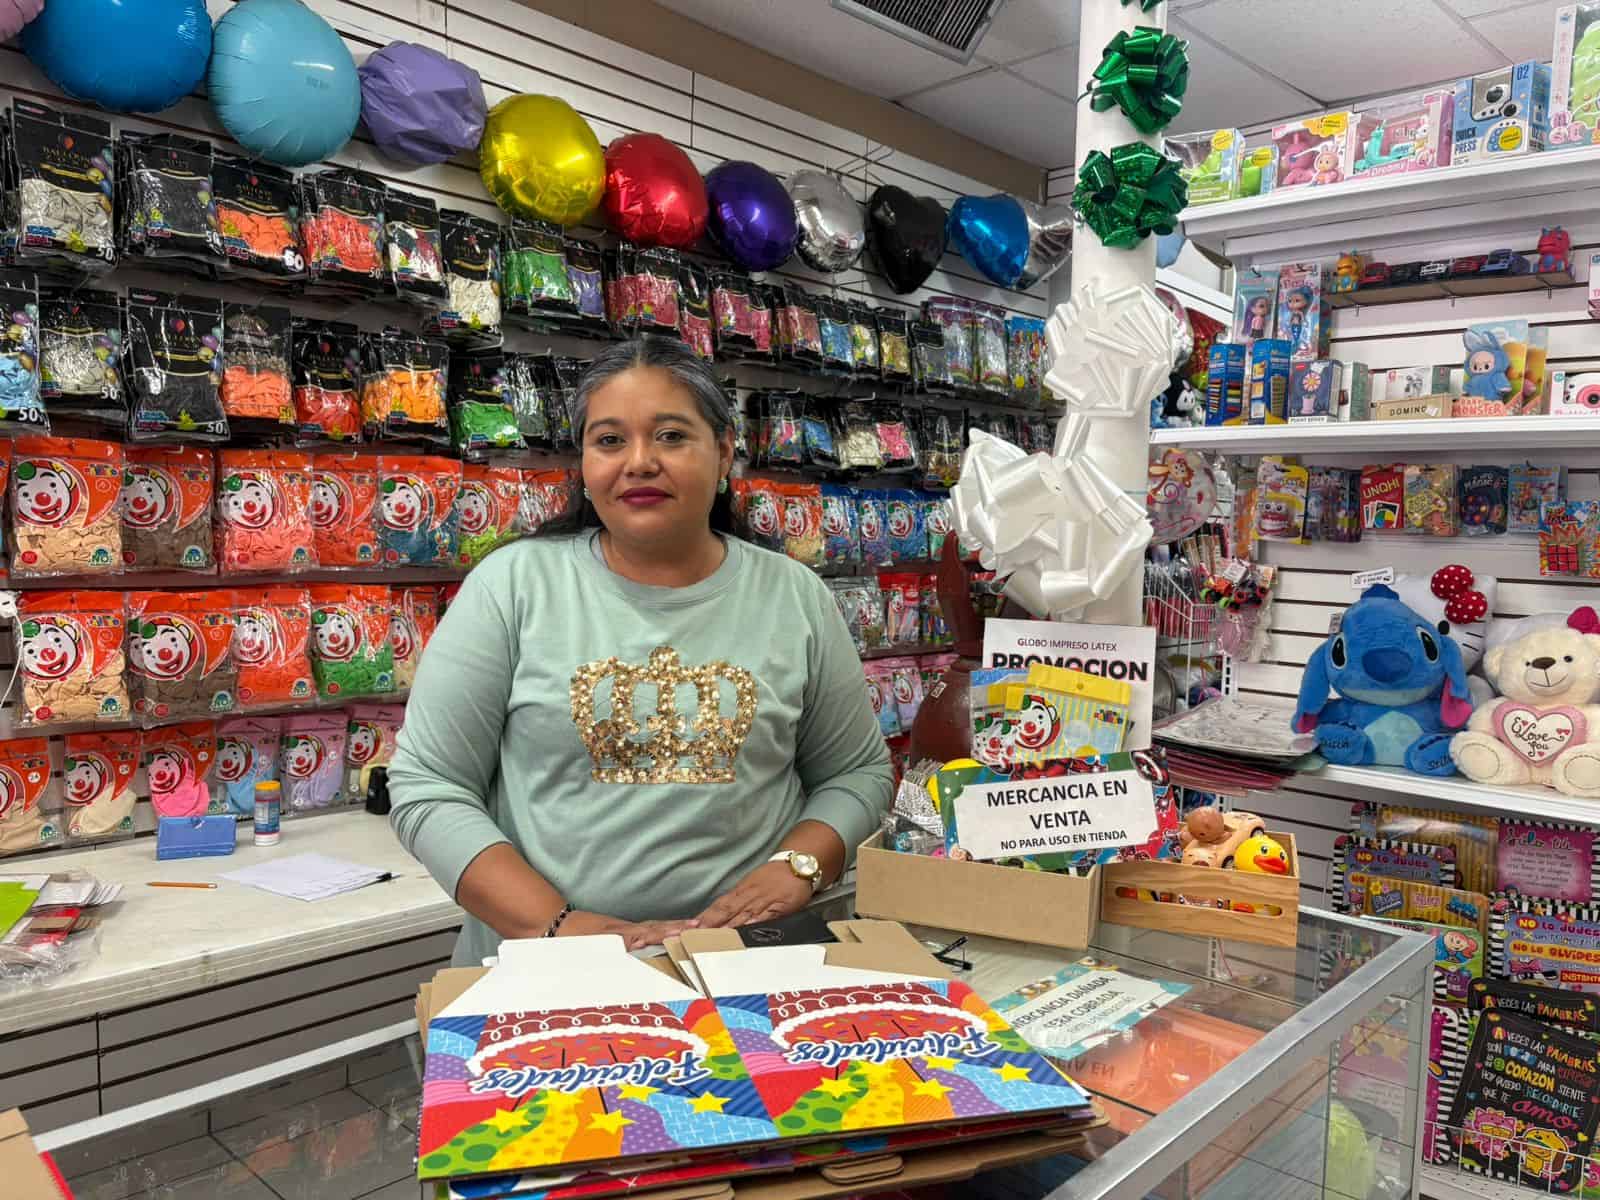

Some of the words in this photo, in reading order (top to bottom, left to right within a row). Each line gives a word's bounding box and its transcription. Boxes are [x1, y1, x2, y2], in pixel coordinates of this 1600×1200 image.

[1456, 127, 1477, 142] QUICK
[1456, 141, 1477, 154] PRESS
[96, 246, 115, 261] 50
[100, 386, 119, 400] 50
[18, 407, 39, 422] 50
[1389, 405, 1427, 417] DOMINO
[206, 422, 224, 434] 50
[1017, 638, 1047, 648] GLOBO
[1050, 640, 1089, 650] IMPRESO
[1091, 642, 1117, 651] LATEX
[992, 653, 1148, 681] PROMOCION
[1515, 722, 1565, 742] Love
[987, 782, 1098, 808] MERCANCIA
[1103, 779, 1128, 797] EN
[1030, 810, 1092, 830] VENTA
[1000, 840, 1017, 851] NO
[1019, 838, 1046, 849] PARA
[1048, 834, 1071, 846] USO
[1073, 833, 1087, 844] EN
[1088, 829, 1128, 842] TIENDA
[1519, 918, 1537, 929] NO
[1512, 942, 1528, 952] NO
[1010, 995, 1071, 1030] MERCANCIA
[1066, 975, 1112, 1004] DAÑADA
[1070, 989, 1122, 1018] COBRADA
[1484, 994, 1496, 1009] A
[1520, 1000, 1536, 1014] LAS
[1537, 1002, 1588, 1021] PALABRAS
[790, 1026, 999, 1066] Felicidades
[1494, 1026, 1506, 1040] A
[1530, 1039, 1546, 1054] LAS
[1545, 1045, 1598, 1073] PALABRAS
[474, 1051, 710, 1096] Felicidades
[1504, 1060, 1556, 1092] CORAZON
